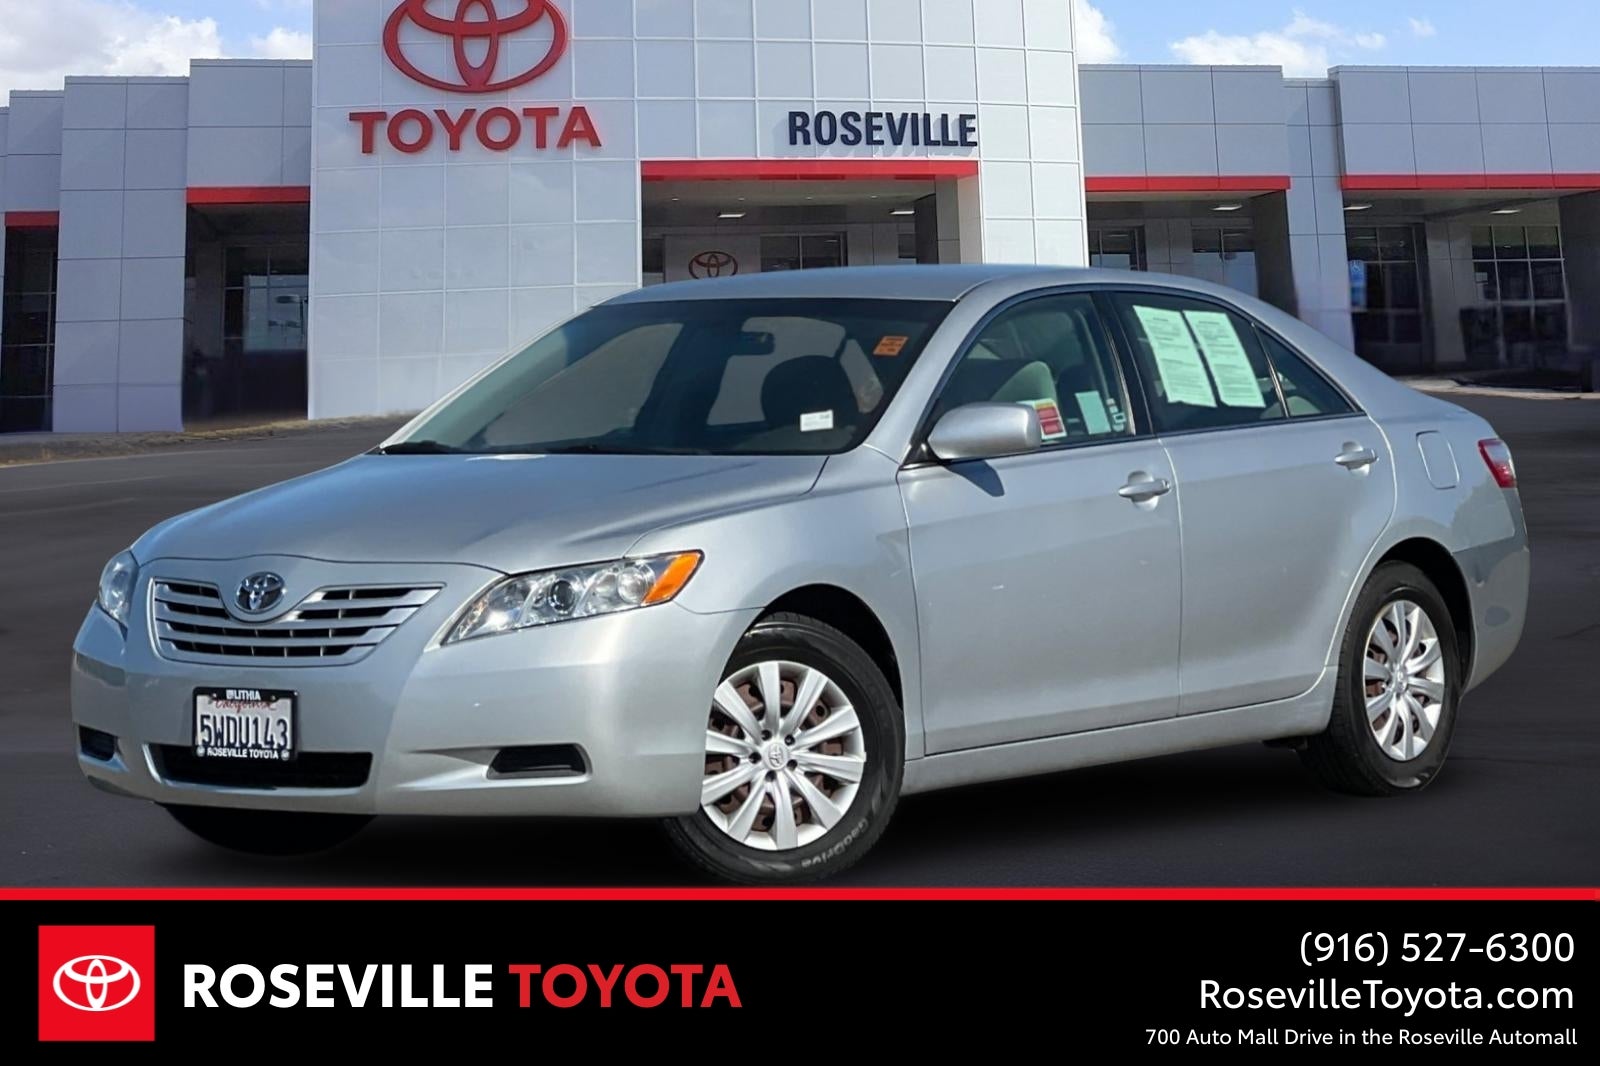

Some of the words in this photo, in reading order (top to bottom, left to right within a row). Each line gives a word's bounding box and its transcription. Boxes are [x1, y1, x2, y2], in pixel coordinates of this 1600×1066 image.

[349, 106, 602, 153] TOYOTA
[788, 111, 978, 147] ROSEVILLE
[233, 689, 261, 700] LITHIA
[200, 714, 288, 749] 5WDU143
[207, 747, 247, 758] ROSEVILLE
[249, 749, 279, 759] TOYOTA
